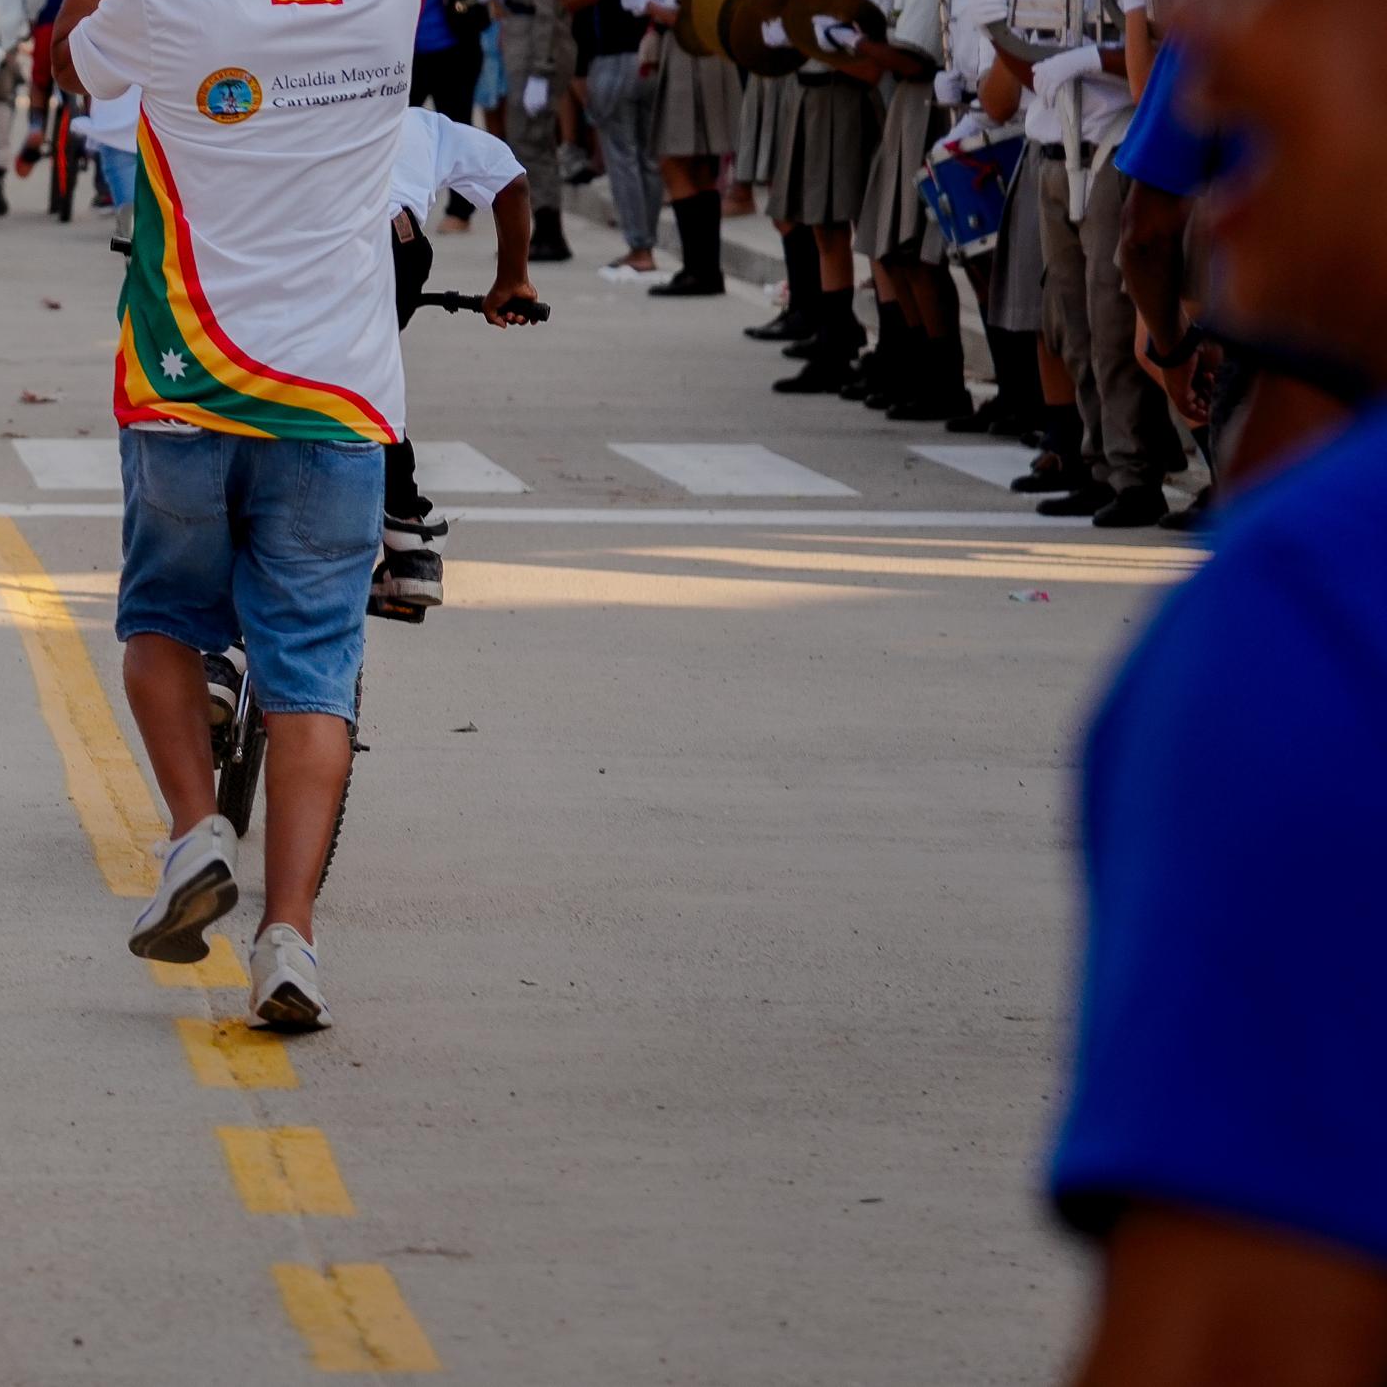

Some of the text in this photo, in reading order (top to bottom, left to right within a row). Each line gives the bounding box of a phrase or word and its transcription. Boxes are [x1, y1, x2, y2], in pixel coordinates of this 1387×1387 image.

[271, 61, 406, 91] Alcaldía Mayor de
